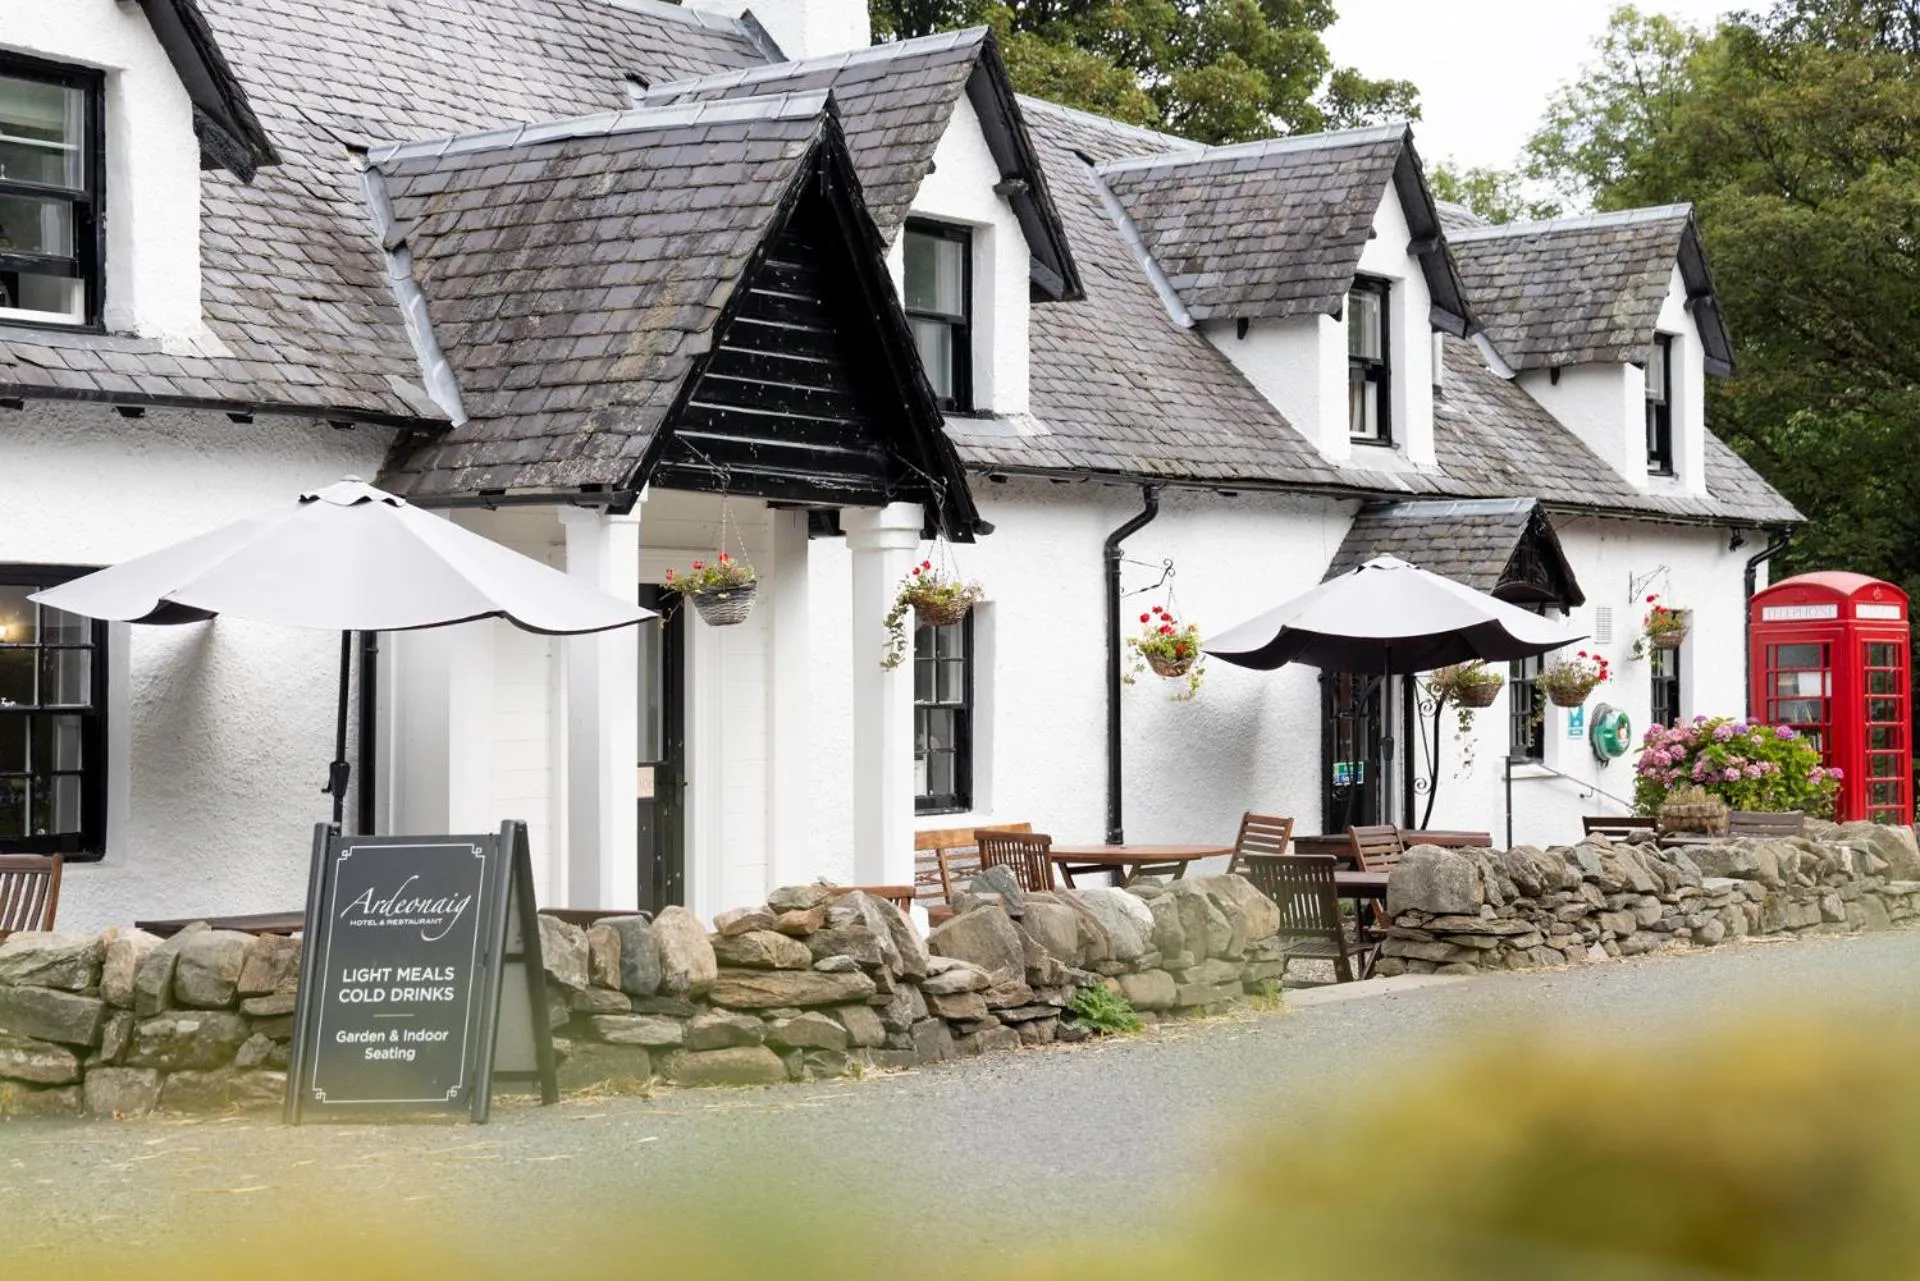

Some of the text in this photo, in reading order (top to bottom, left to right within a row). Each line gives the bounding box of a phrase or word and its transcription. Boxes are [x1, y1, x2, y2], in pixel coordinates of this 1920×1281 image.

[1766, 605, 1836, 619] TELEPHONE
[340, 874, 472, 941] Ardeonaig
[350, 918, 378, 926] HOTEL
[386, 917, 443, 926] RESTAURANT
[343, 967, 455, 983] LIGHT MEALS
[338, 987, 455, 1003] COLD DRINKS
[336, 1028, 449, 1043] Garden & Indoor
[364, 1047, 416, 1061] Seating
